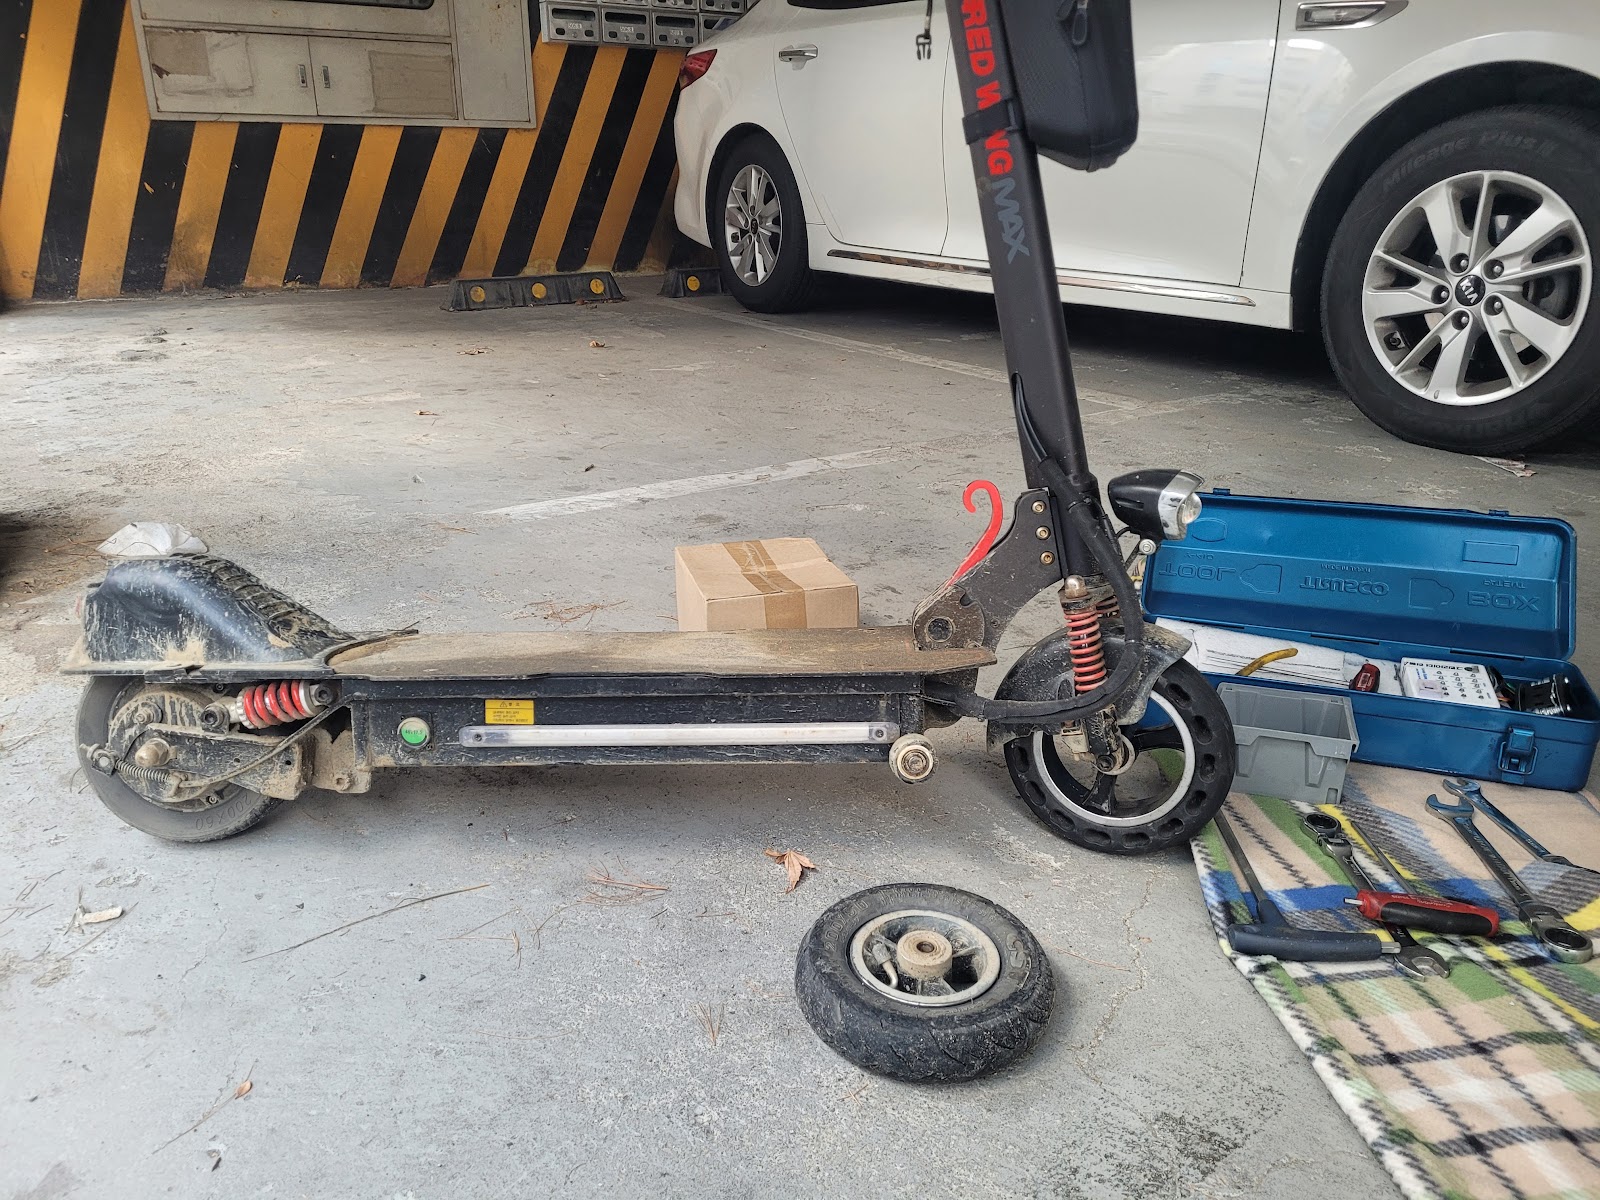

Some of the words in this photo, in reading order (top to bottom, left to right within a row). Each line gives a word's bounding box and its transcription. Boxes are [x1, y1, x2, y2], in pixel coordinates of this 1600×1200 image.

[961, 0, 995, 76] RED
[976, 80, 1014, 175] WNG
[992, 177, 1030, 264] MAX
[1460, 278, 1478, 304] KIA
